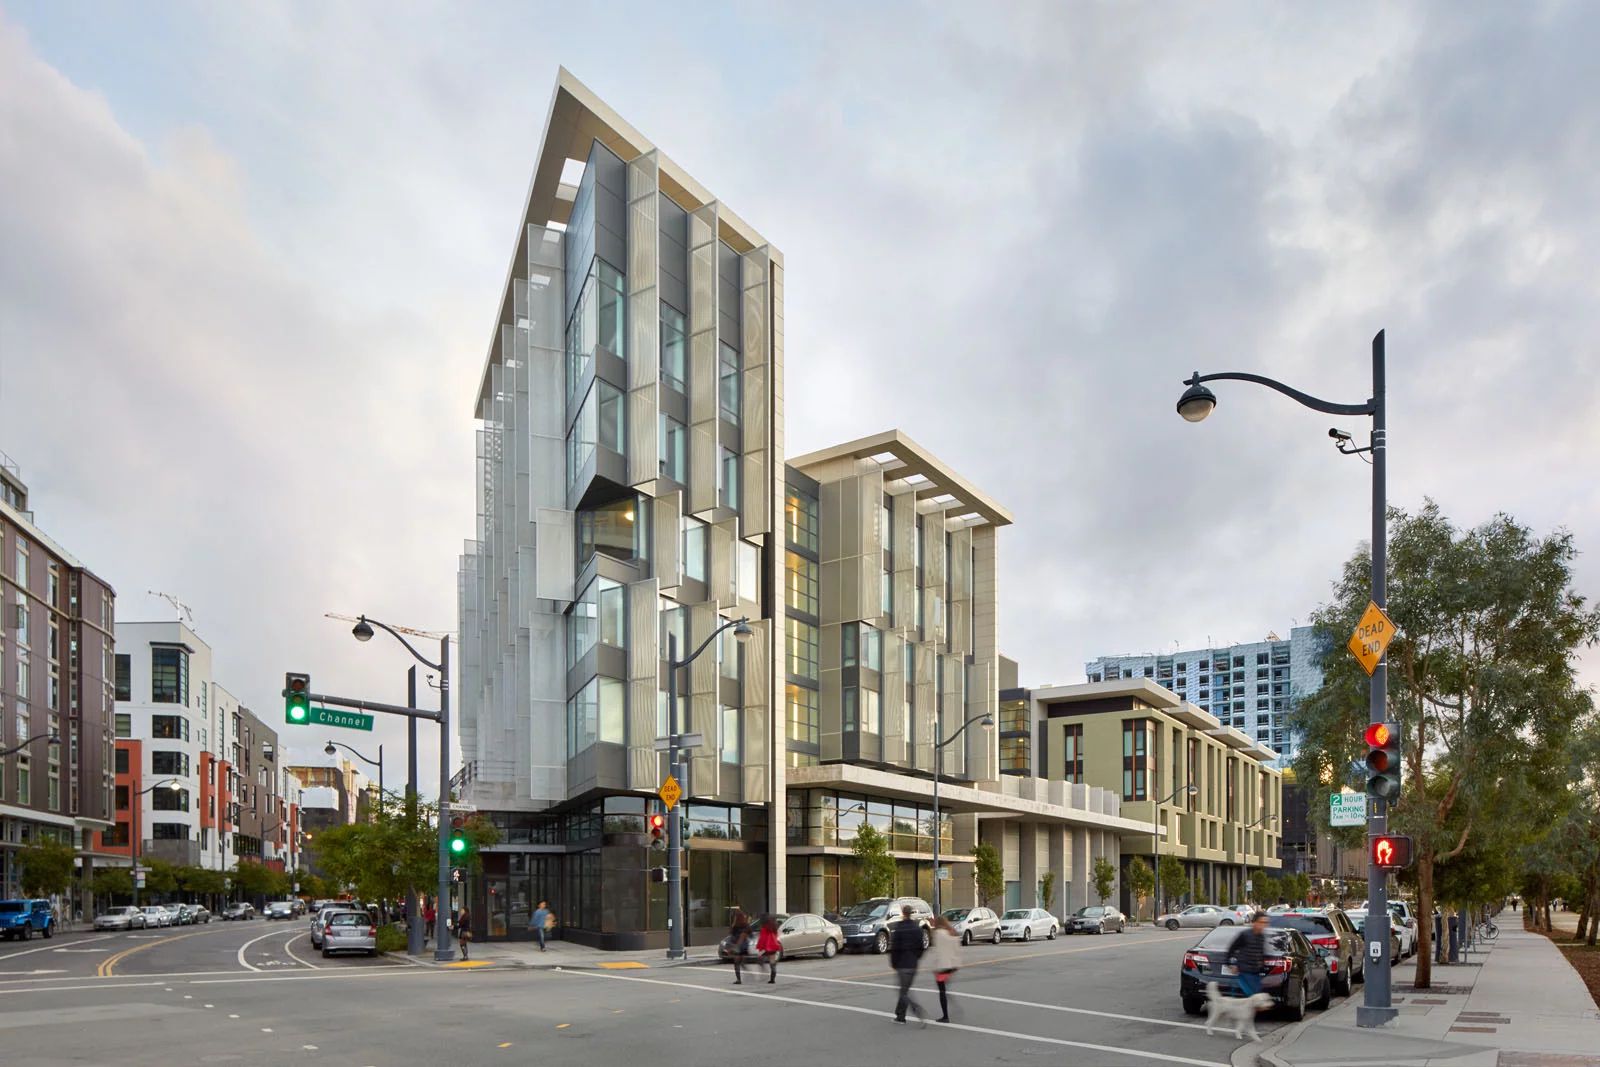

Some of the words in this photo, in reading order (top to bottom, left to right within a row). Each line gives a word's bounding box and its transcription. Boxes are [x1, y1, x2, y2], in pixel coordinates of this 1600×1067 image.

[1358, 620, 1385, 640] DEAD
[1362, 640, 1381, 657] END
[319, 711, 365, 727] Channel
[663, 785, 678, 793] DEAD
[1332, 795, 1341, 805] 2
[1344, 795, 1363, 803] HOUR
[1332, 805, 1364, 814] PARKING
